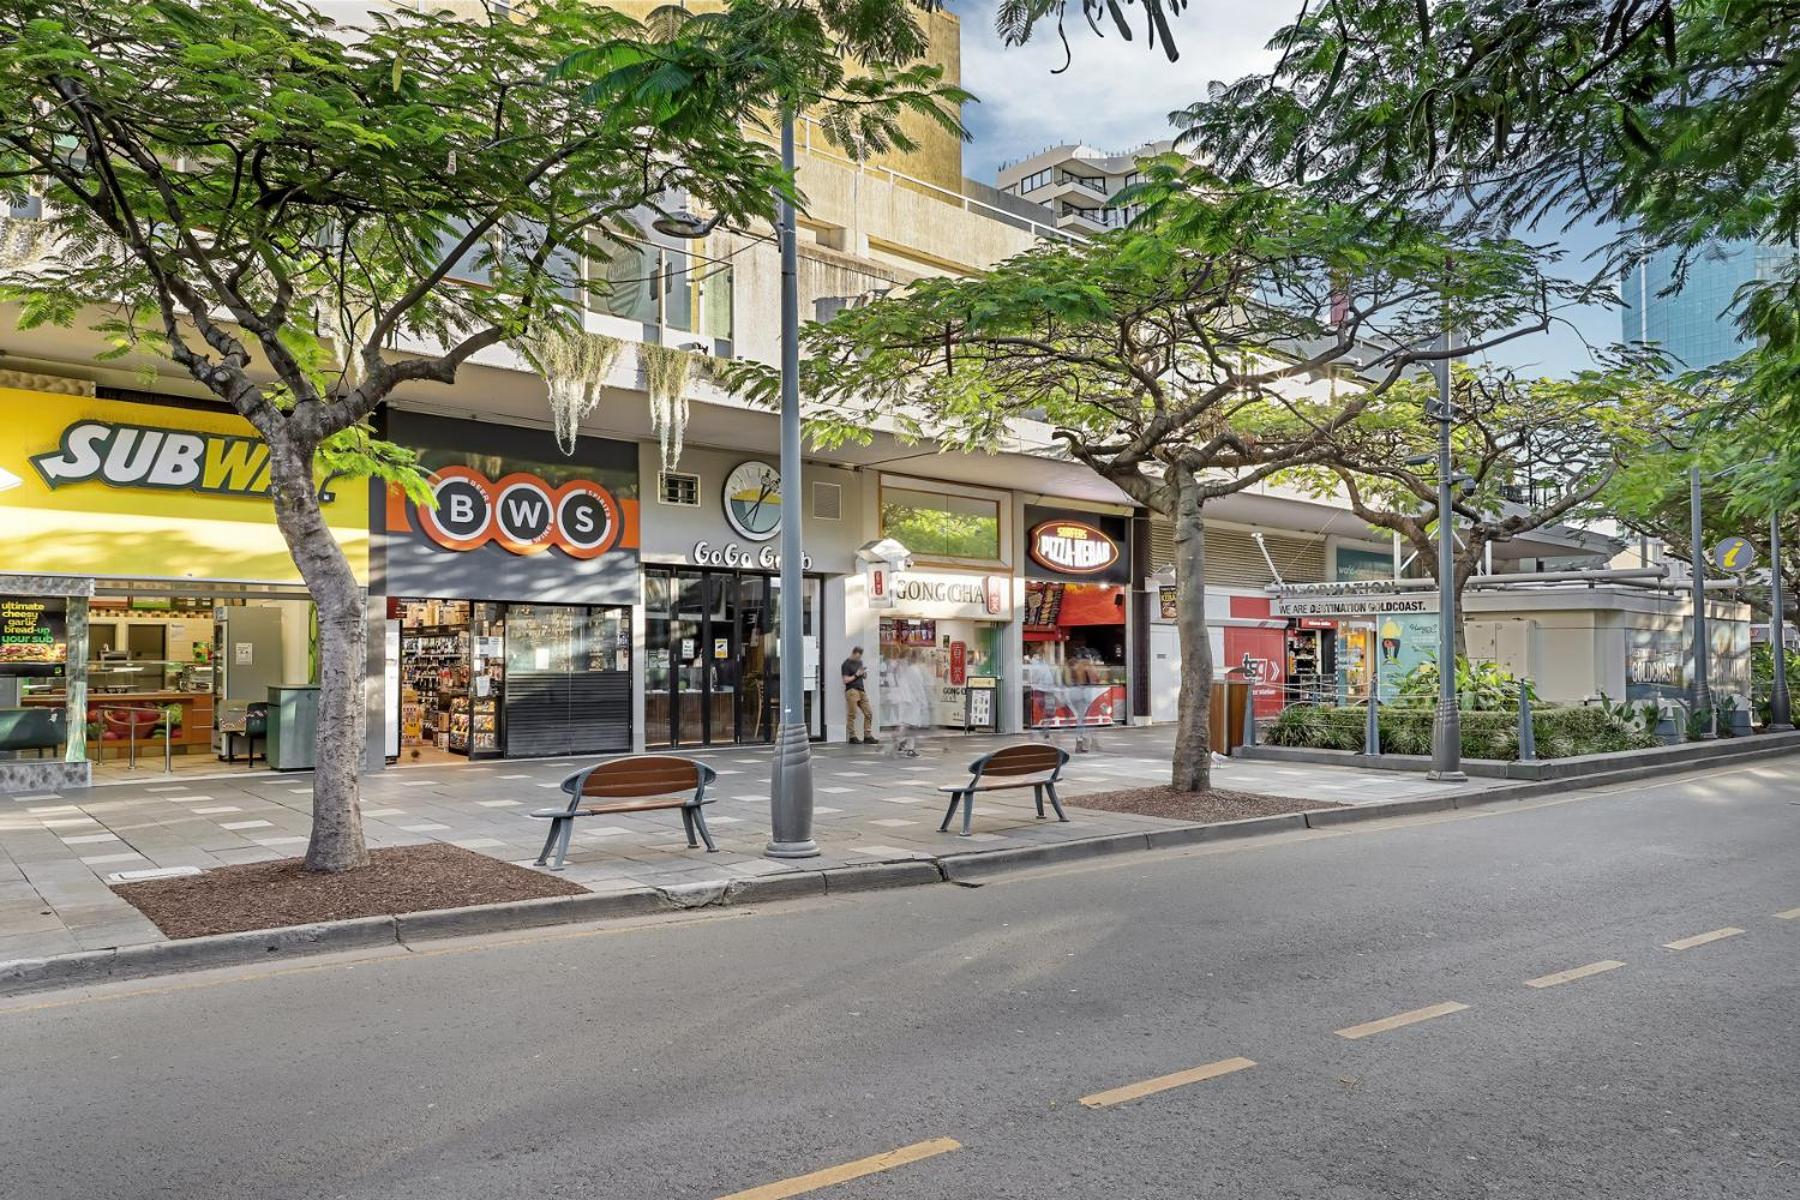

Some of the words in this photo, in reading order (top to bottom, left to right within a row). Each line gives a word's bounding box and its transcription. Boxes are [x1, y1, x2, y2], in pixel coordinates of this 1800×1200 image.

[760, 546, 812, 570] Grb
[896, 580, 946, 601] GONG
[1281, 581, 1395, 597] INFORMATION
[1, 601, 45, 610] ultimate
[1279, 603, 1291, 614] WE
[1293, 604, 1307, 614] ARE
[1309, 602, 1366, 613] DESTINATION
[2, 610, 38, 619] cheesy
[8, 618, 37, 627] garlic
[4, 625, 50, 635] bread-up
[1, 635, 30, 645] your
[32, 634, 54, 643] sub
